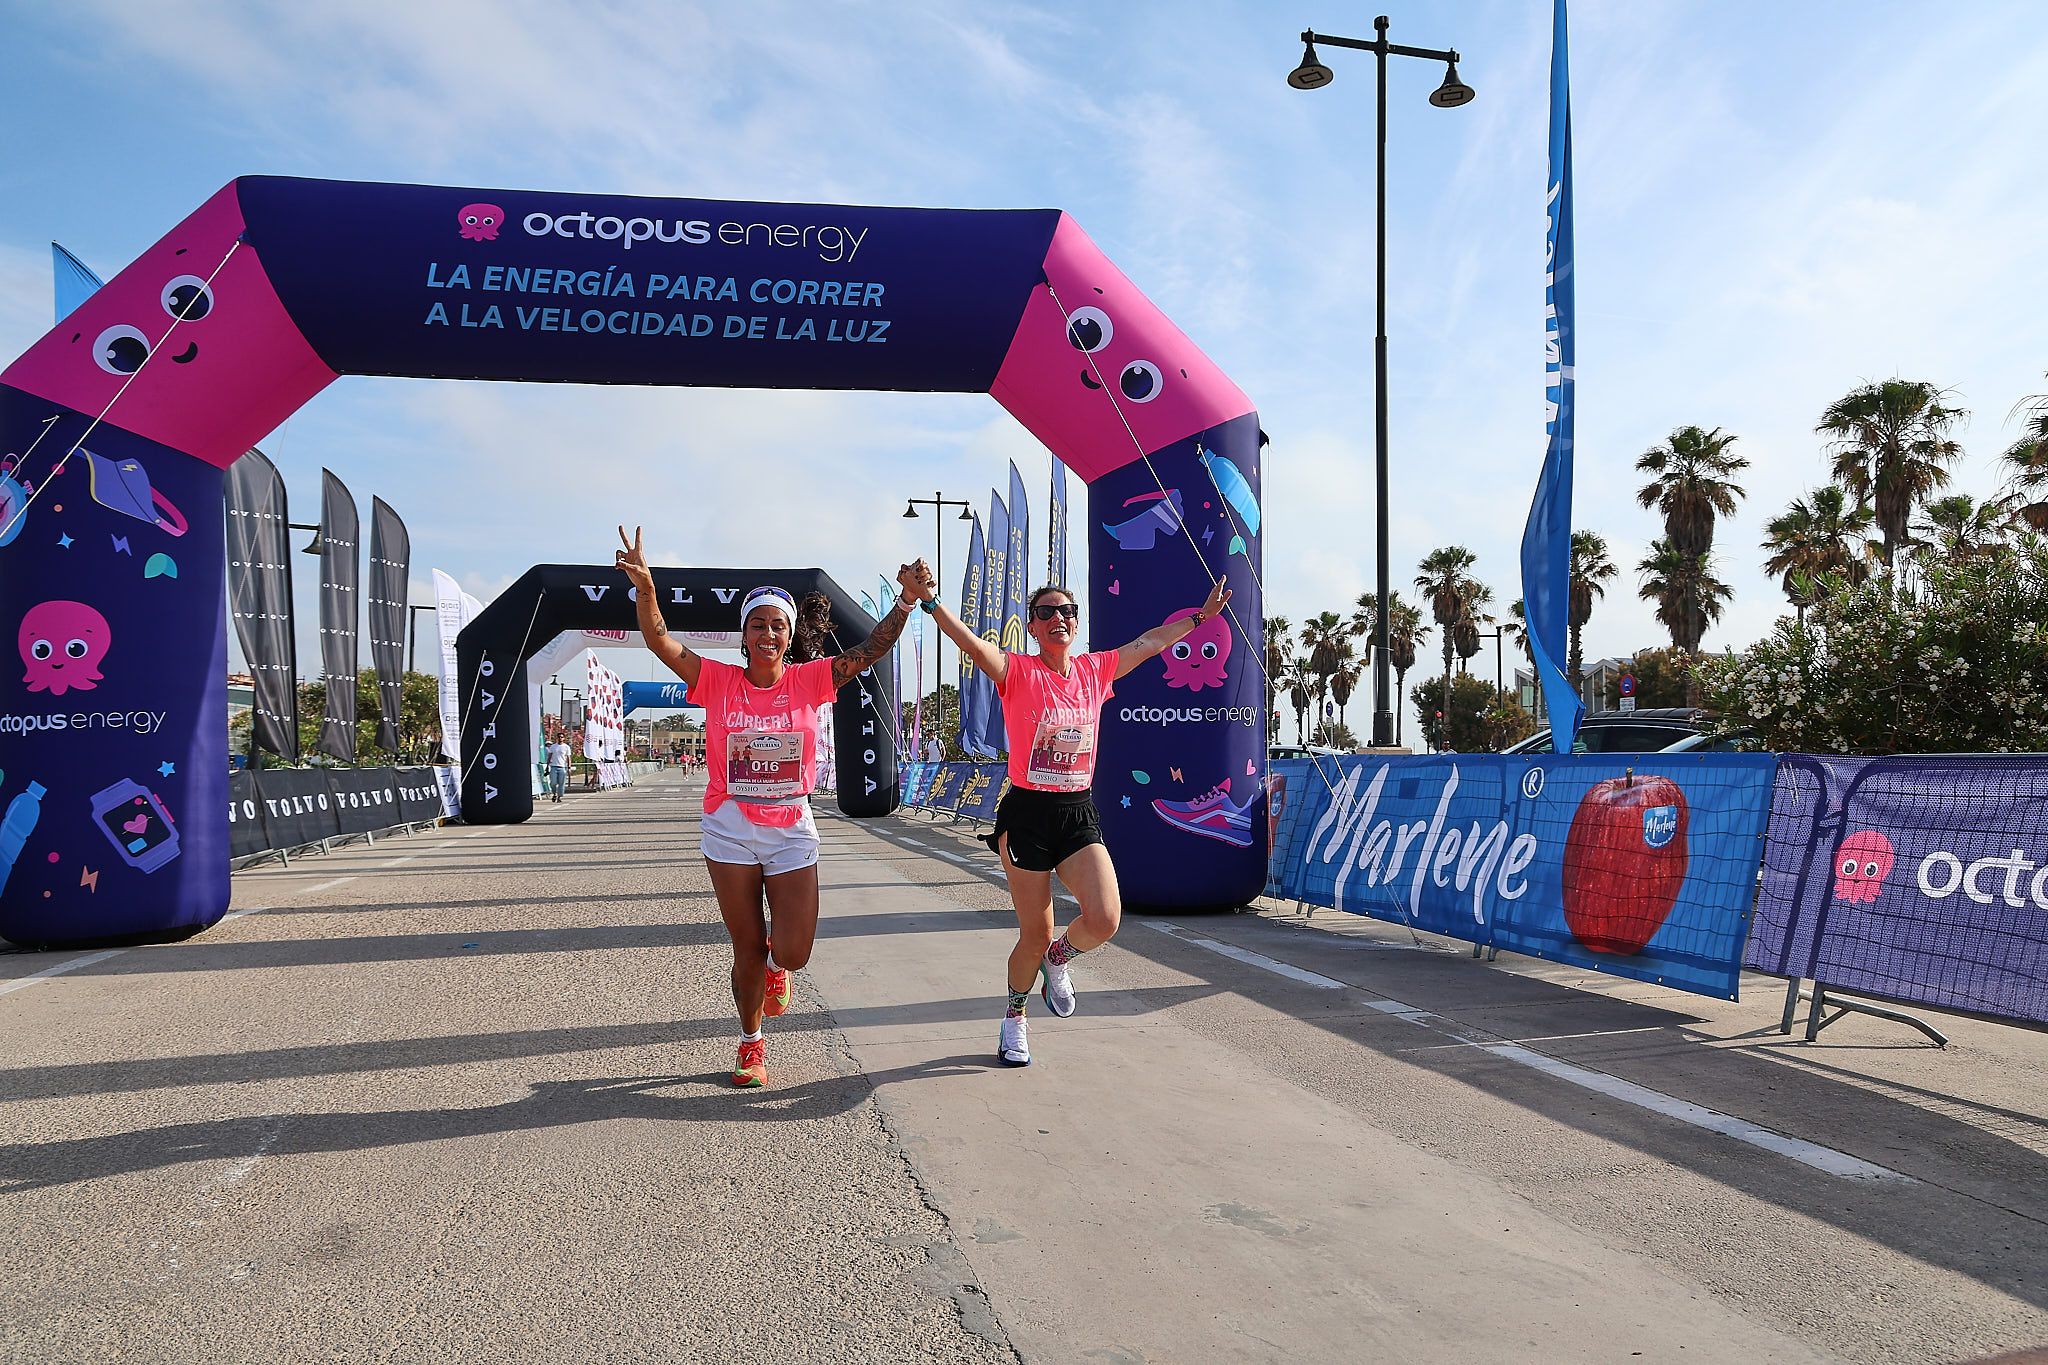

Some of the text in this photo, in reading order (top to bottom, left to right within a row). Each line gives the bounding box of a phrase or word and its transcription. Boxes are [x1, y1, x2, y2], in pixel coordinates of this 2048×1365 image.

[522, 211, 868, 263] octopus energy
[426, 262, 885, 307] LA ENERGÍA PARA CORRER
[424, 302, 891, 343] A LA VELOCIDAD DE LA LUZ
[580, 585, 740, 603] VLV
[661, 684, 687, 705] Mar
[0, 711, 166, 737] ctopus energy
[727, 711, 791, 729] CARRERA
[1120, 705, 1258, 727] octopus energy
[481, 660, 498, 804] VOLVO
[751, 760, 780, 772] 016
[1053, 752, 1078, 764] 016
[266, 793, 328, 818] VOLVO
[336, 788, 393, 809] VOLVO
[399, 784, 438, 802] VOLVO
[1306, 763, 1537, 925] Marlene
